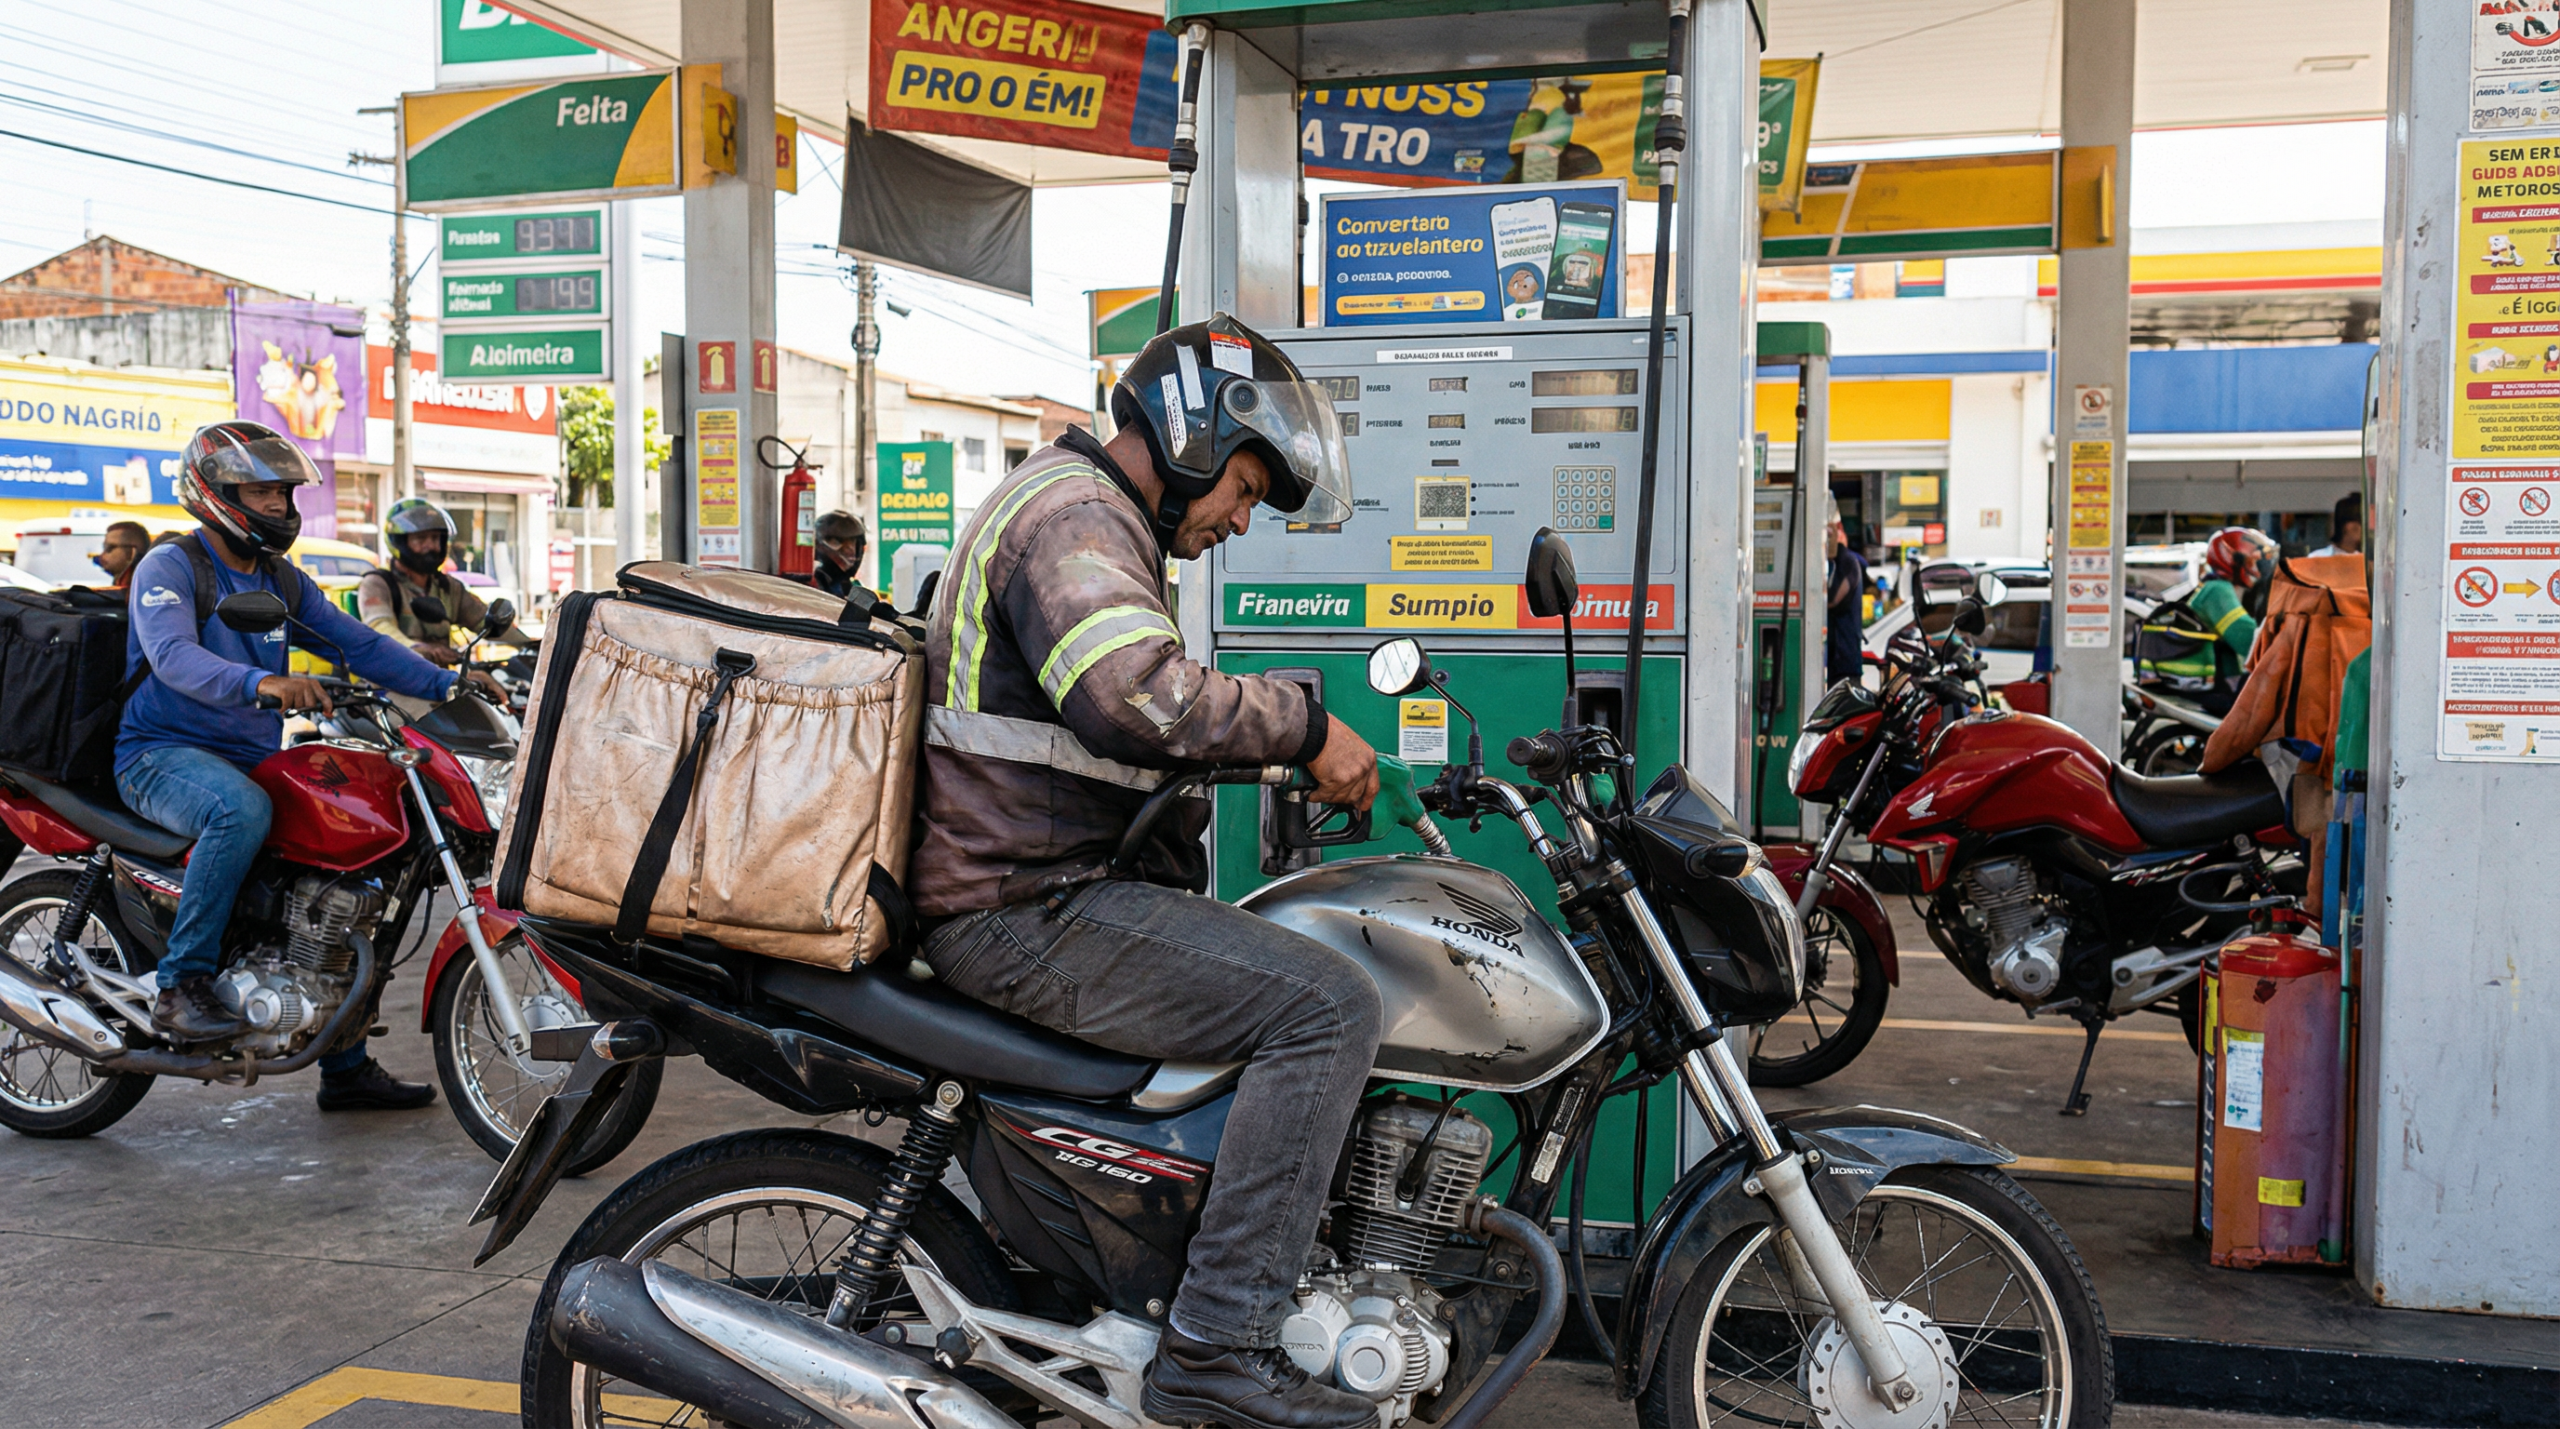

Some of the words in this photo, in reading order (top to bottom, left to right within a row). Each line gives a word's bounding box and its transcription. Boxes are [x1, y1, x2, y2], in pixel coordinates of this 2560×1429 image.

[899, 63, 982, 104] PRO
[989, 75, 1018, 108] O
[1023, 72, 1095, 118] ÉM!
[1340, 122, 1430, 166] TRO
[2489, 148, 2525, 162] SEM
[1388, 592, 1494, 621] Sumpio
[1430, 915, 1525, 959] HONDA
